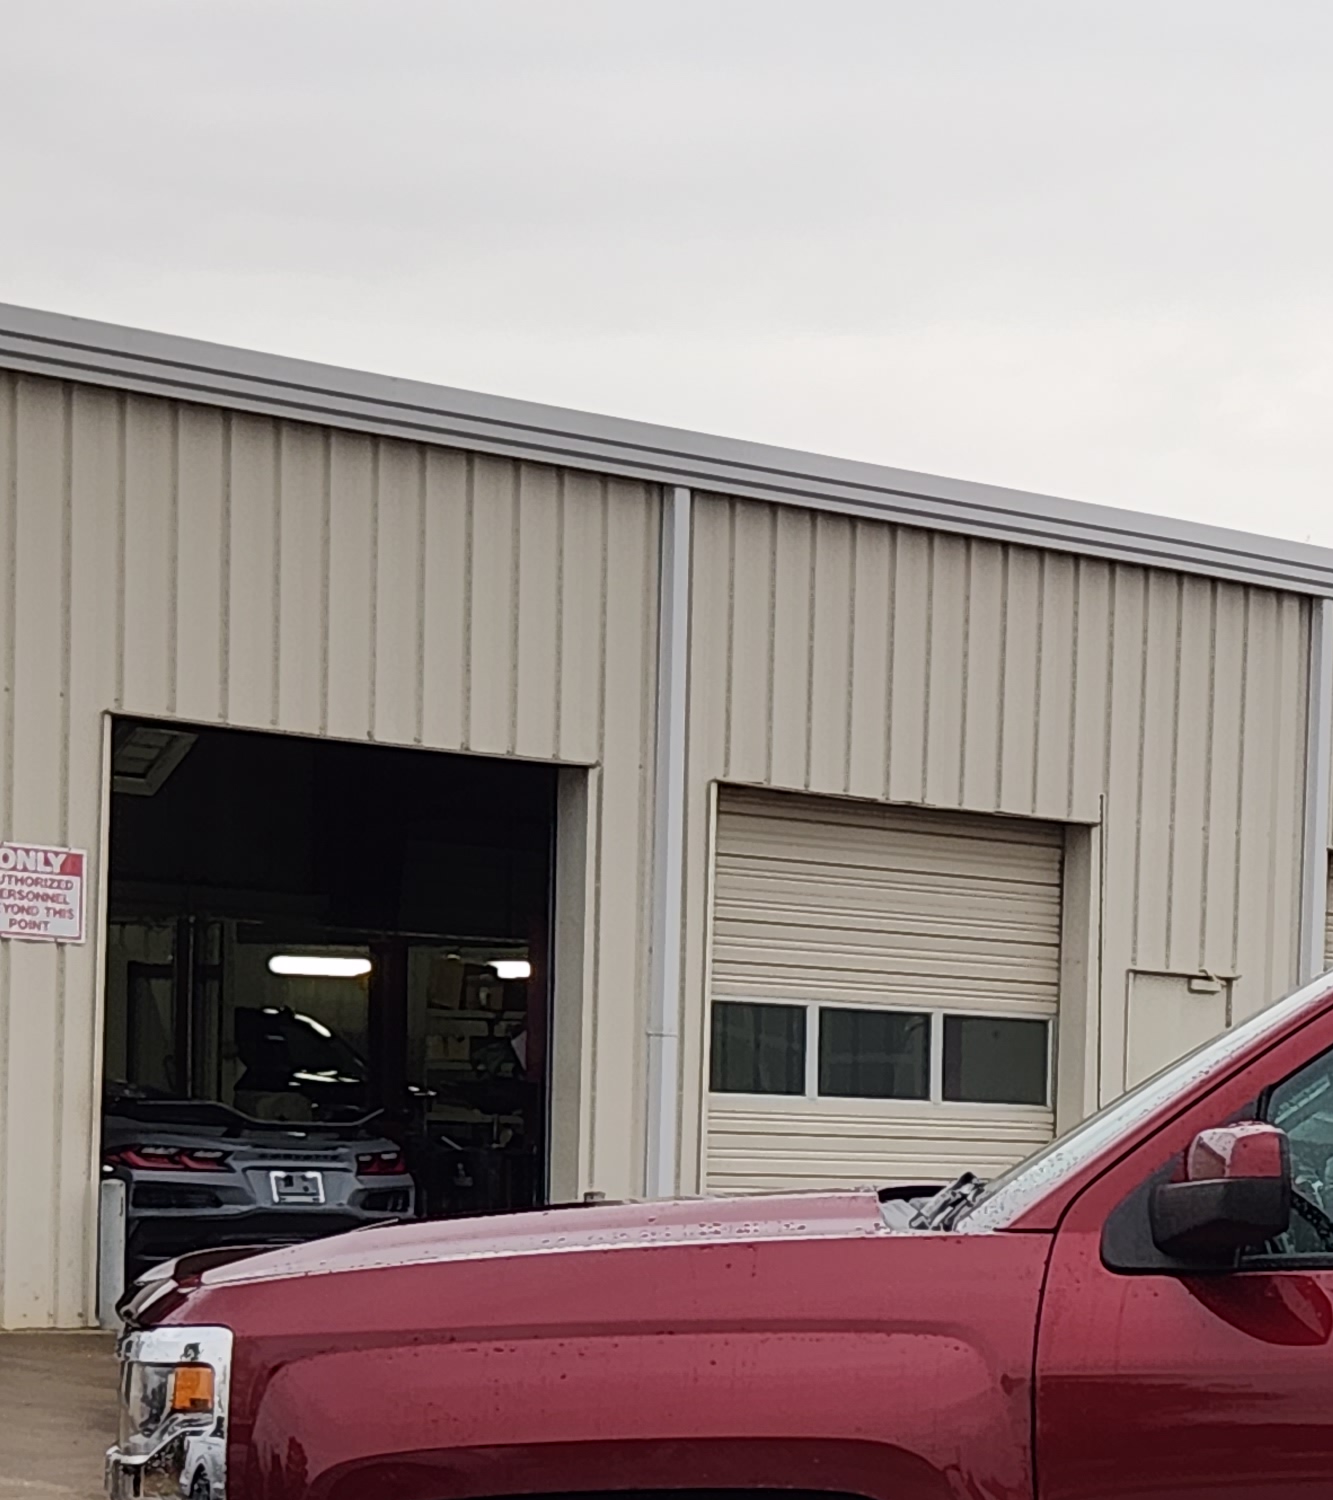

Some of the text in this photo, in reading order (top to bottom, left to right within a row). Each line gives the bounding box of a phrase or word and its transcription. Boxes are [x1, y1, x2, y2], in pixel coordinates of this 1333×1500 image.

[0, 848, 68, 873] ONLY
[0, 902, 75, 920] YOND THIS
[9, 918, 50, 931] POINT
